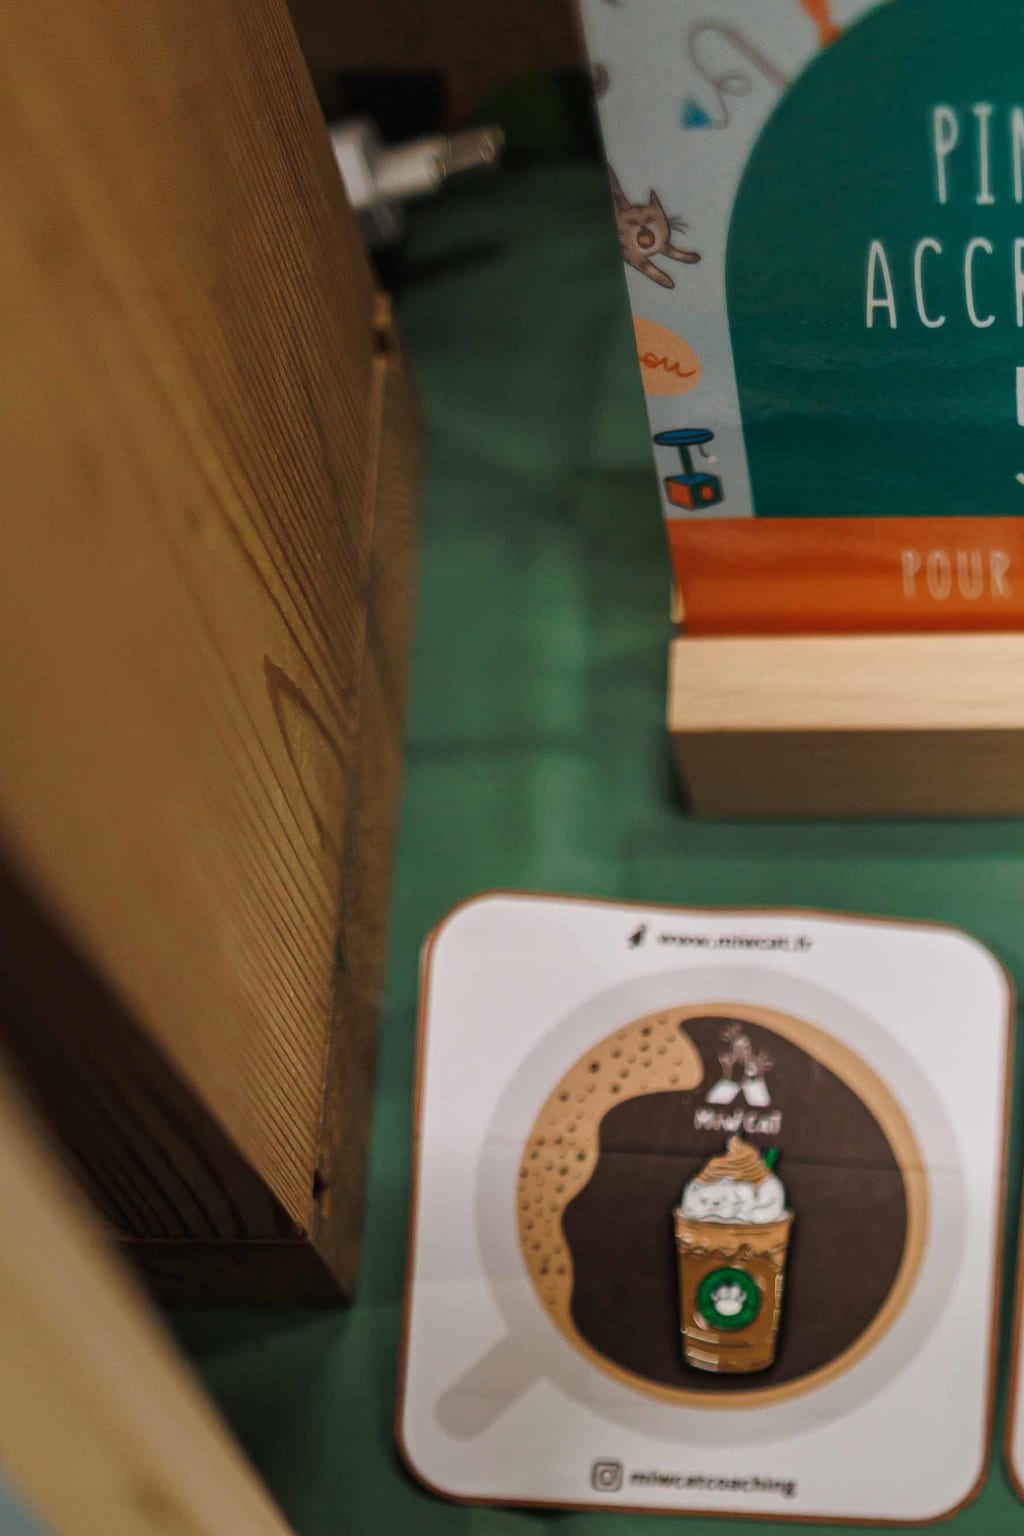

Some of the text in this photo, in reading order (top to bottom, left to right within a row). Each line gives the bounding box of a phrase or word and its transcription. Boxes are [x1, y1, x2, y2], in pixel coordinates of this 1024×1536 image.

[900, 549, 1012, 600] POUR
[657, 932, 813, 953] www.miwcat.fr
[630, 1469, 796, 1496] miwcatcoaching
